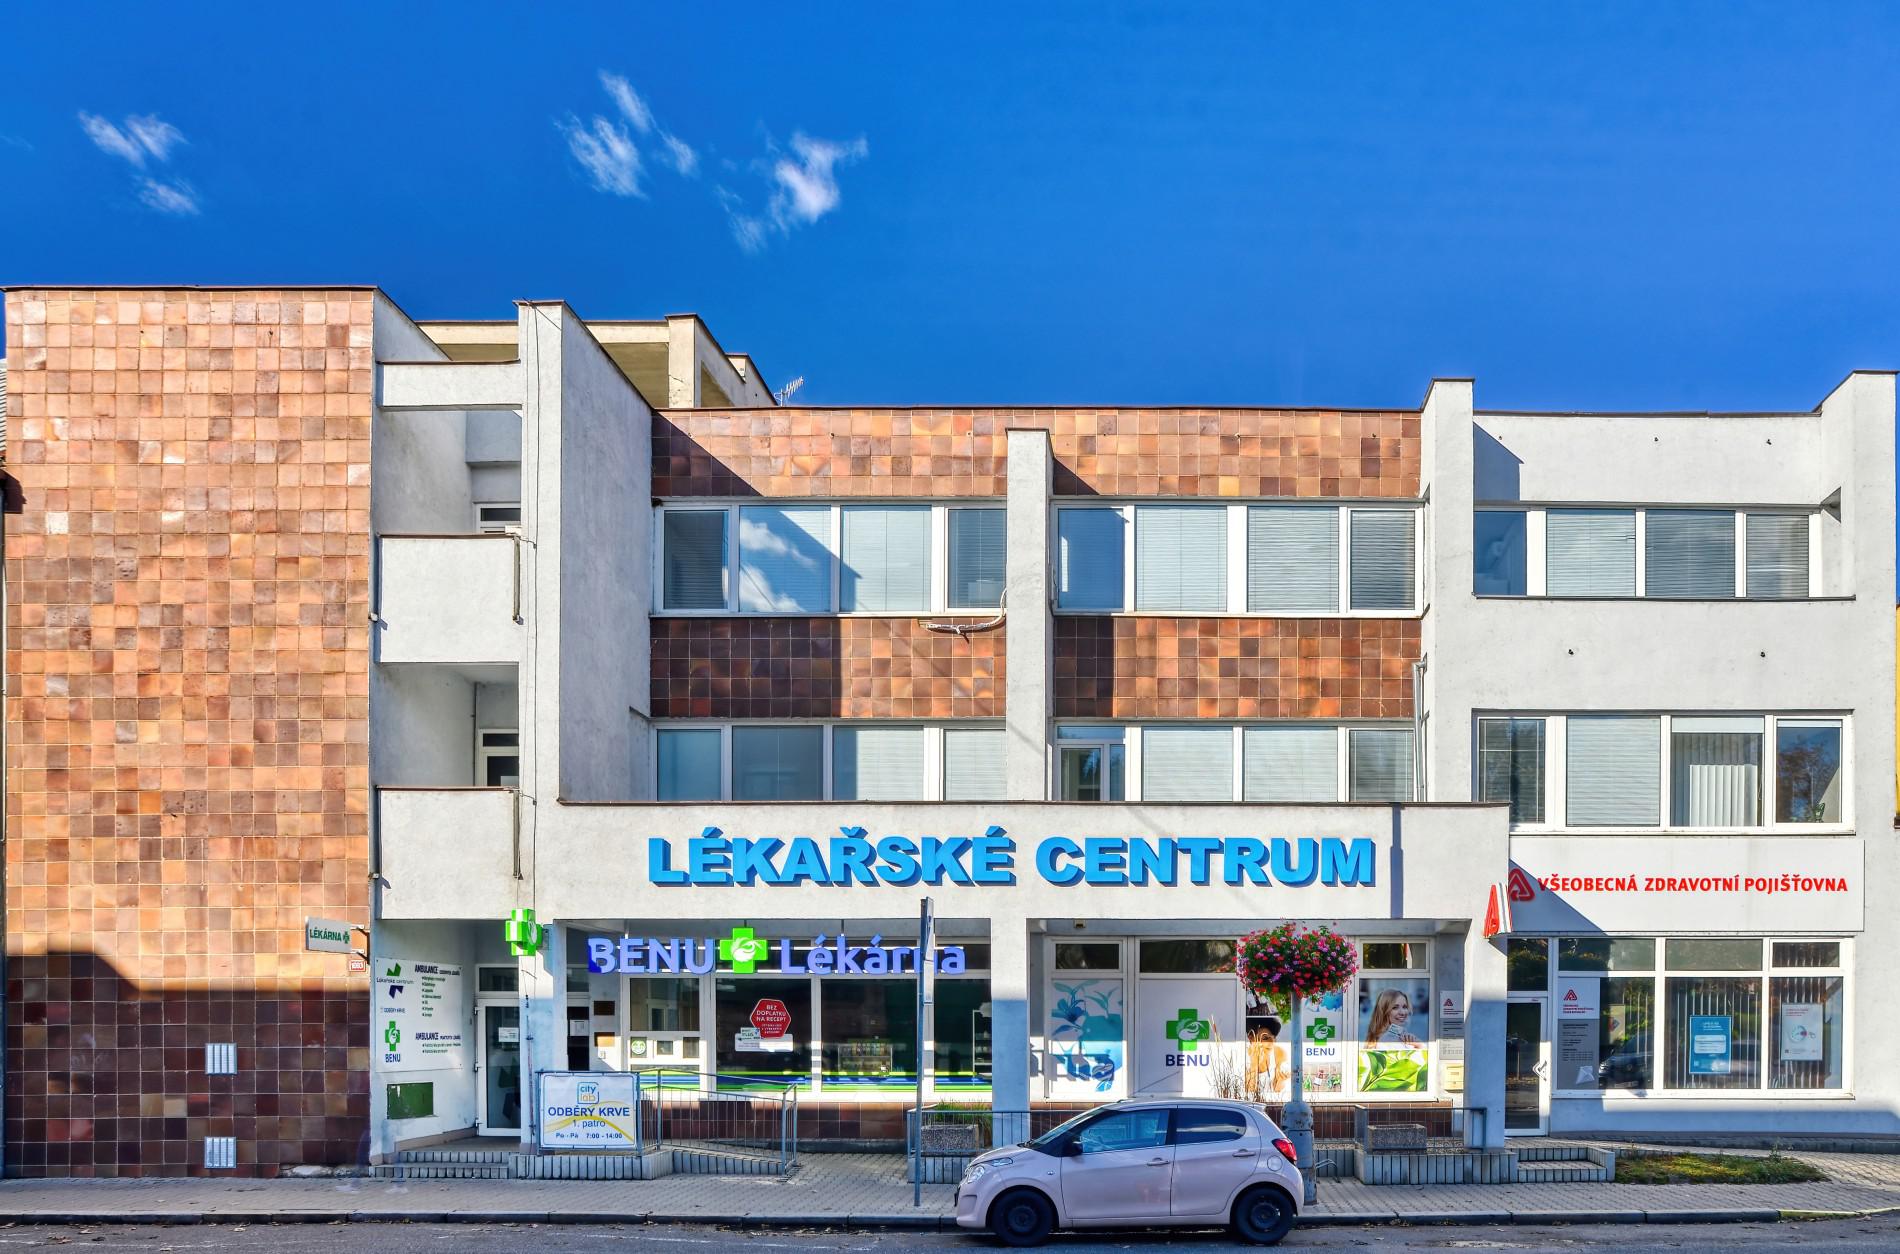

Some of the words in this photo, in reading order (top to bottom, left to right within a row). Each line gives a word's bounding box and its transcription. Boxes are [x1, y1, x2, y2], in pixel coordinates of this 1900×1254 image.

[649, 827, 1016, 887] LÉKAŘSKÉ
[1036, 837, 1376, 887] CENTRUM
[1538, 873, 1638, 892] VŠEOBECNÁ
[1644, 873, 1739, 892] ZDRAVOTNÍ
[1745, 873, 1848, 894] POJIŠŤOVNA
[309, 926, 342, 941] LÉKÁRNA
[587, 937, 715, 975] BENU
[1306, 1048, 1335, 1056] BENU
[385, 1053, 401, 1063] BENU
[1165, 1054, 1210, 1067] BENU
[580, 1085, 596, 1094] city
[581, 1093, 595, 1101] lab
[548, 1105, 595, 1116] ODBĚRY
[599, 1108, 630, 1116] KRVE
[582, 1120, 606, 1129] patro
